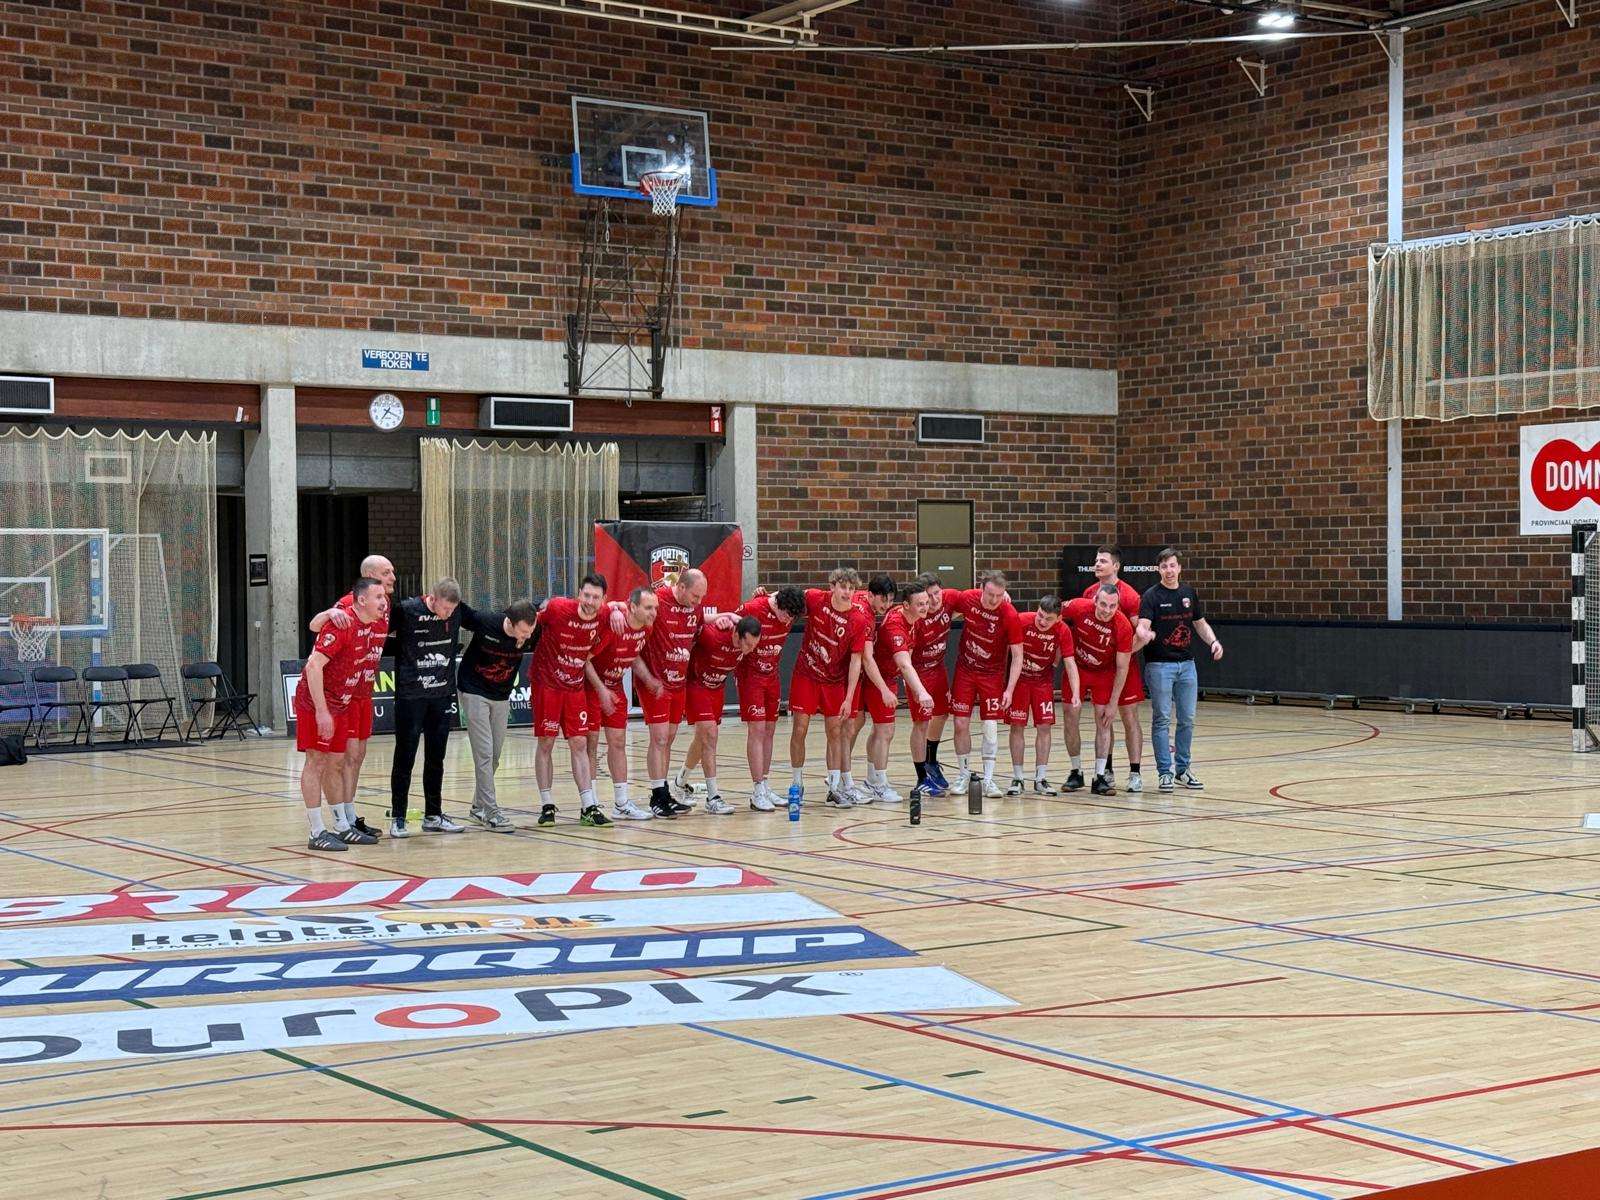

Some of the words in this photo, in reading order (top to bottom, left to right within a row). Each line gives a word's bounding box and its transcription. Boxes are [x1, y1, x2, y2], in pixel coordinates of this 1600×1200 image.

[364, 350, 412, 360] VERBODEN
[415, 353, 428, 361] TE
[380, 360, 412, 369] ROKEN
[1530, 519, 1572, 527] PROVINCIAAL
[687, 615, 697, 627] 22
[589, 630, 597, 640] 9
[1099, 634, 1112, 647] 11
[1042, 641, 1055, 653] 14
[985, 698, 1000, 712] 13
[1040, 701, 1054, 715] 14
[579, 710, 588, 726] 9
[0, 931, 866, 996] UROQUIP
